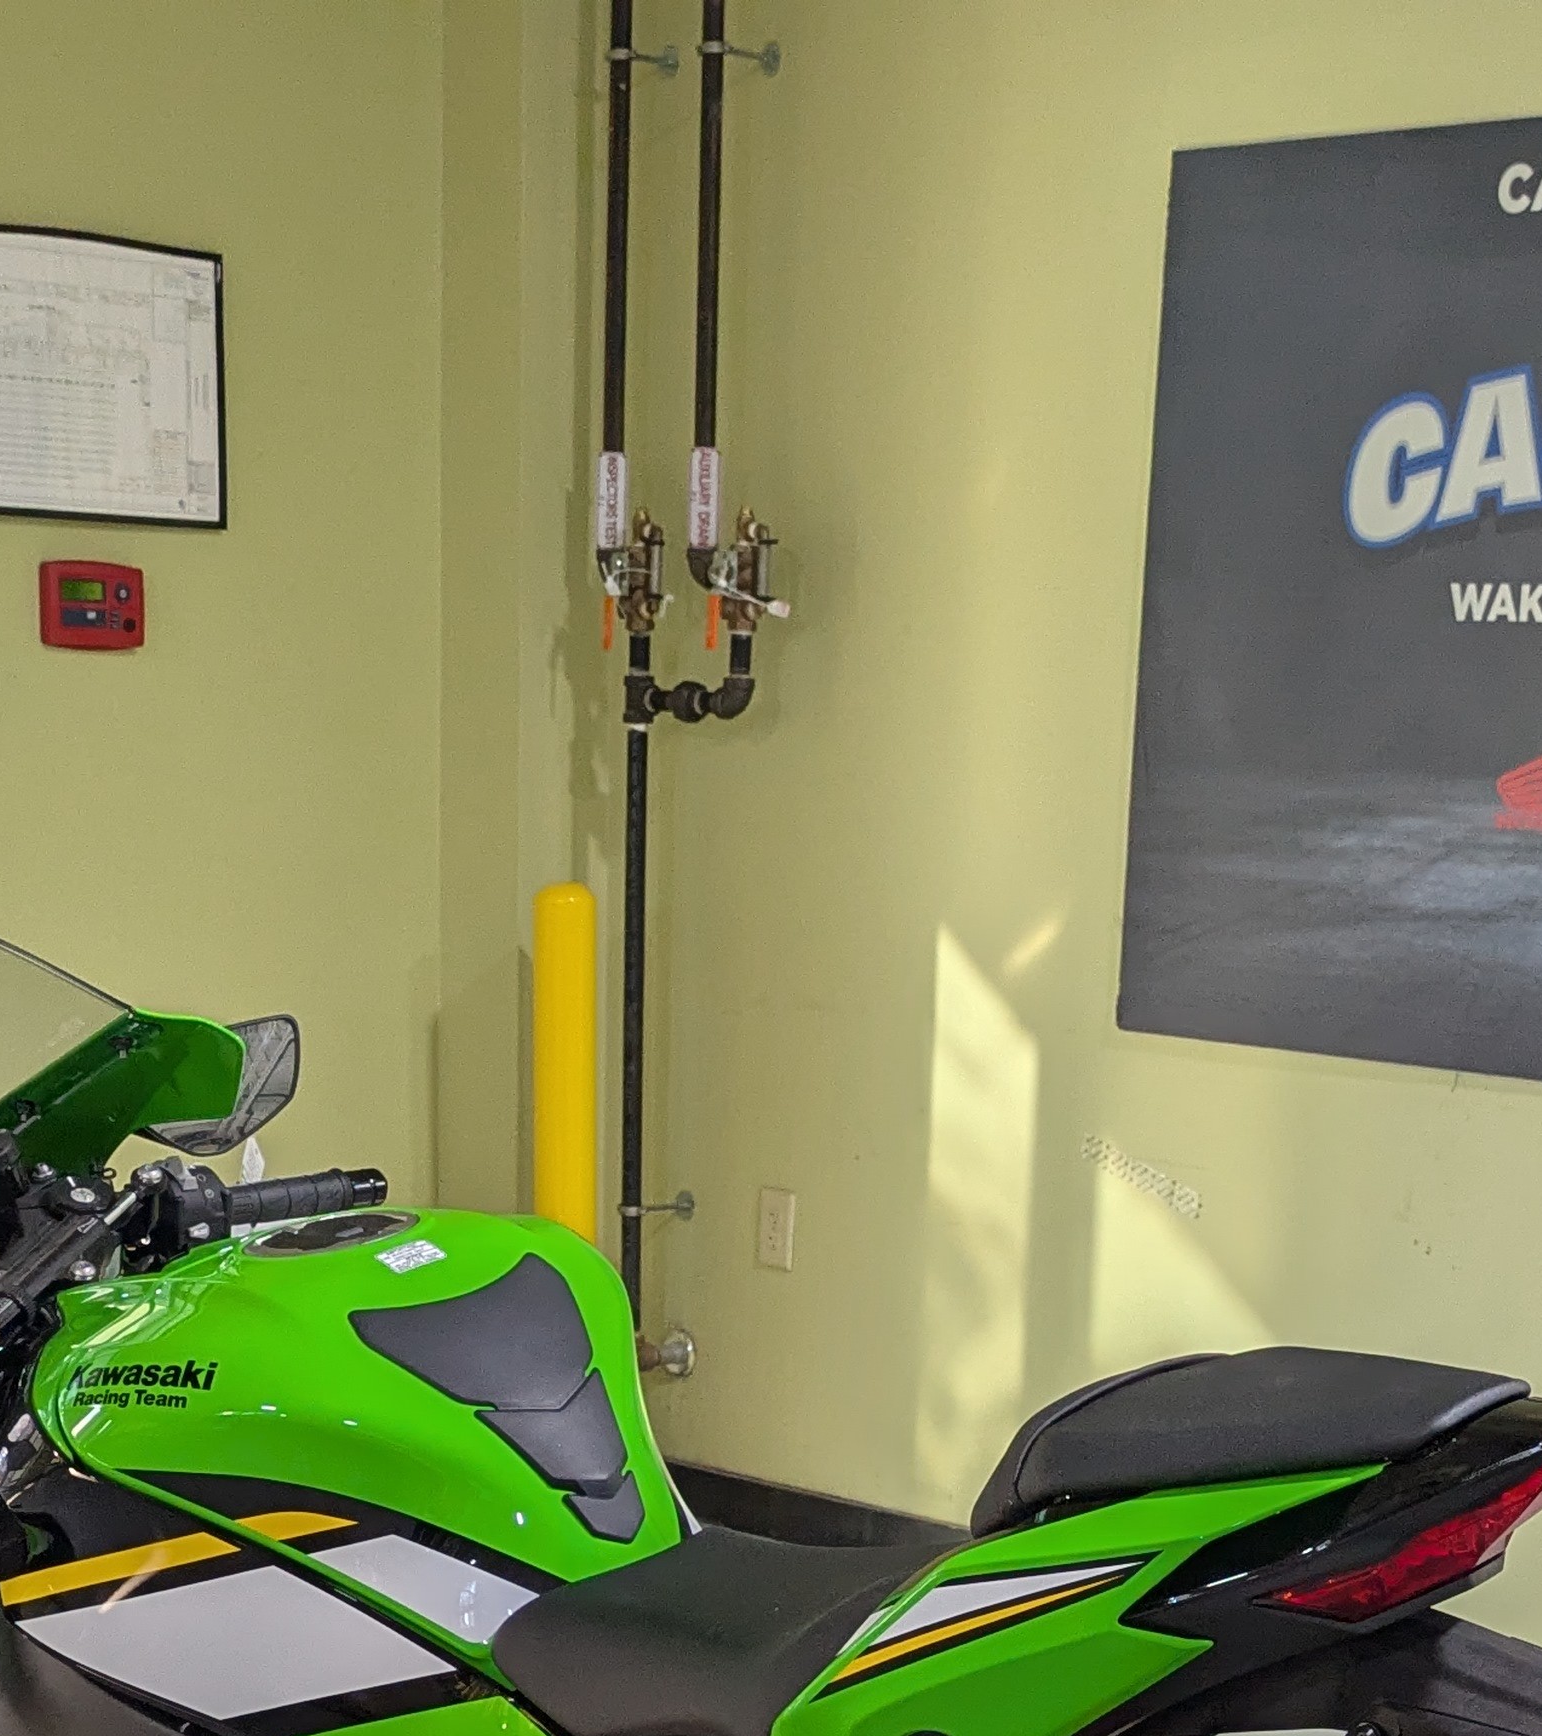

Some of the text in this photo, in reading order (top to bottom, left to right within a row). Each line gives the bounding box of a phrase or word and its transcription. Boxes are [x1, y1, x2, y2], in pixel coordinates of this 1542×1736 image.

[66, 1359, 219, 1391] Kawasaki
[72, 1389, 189, 1409] Racing Team
